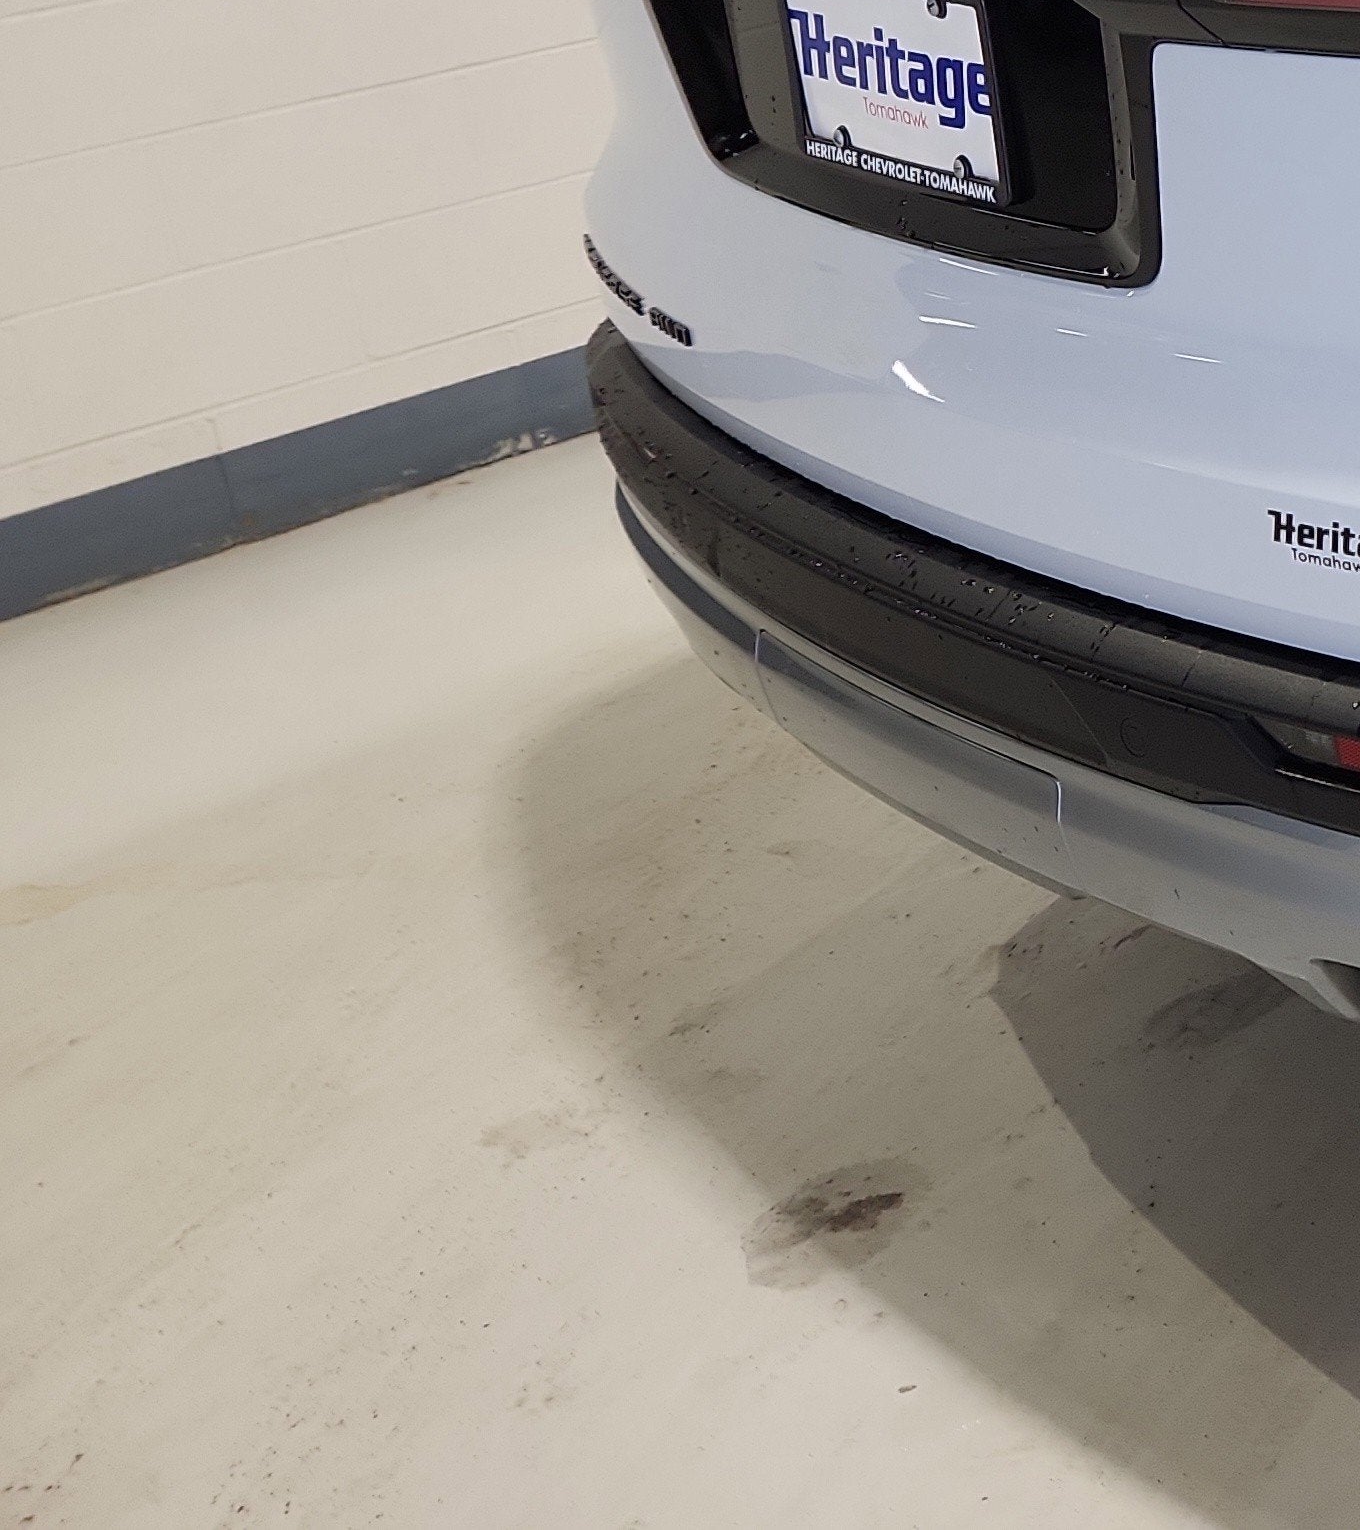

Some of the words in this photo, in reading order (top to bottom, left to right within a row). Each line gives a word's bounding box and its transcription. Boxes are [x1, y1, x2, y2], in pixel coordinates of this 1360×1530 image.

[788, 8, 992, 129] Heritage
[863, 97, 929, 129] Tomahawk
[806, 140, 859, 167] HERITAGE
